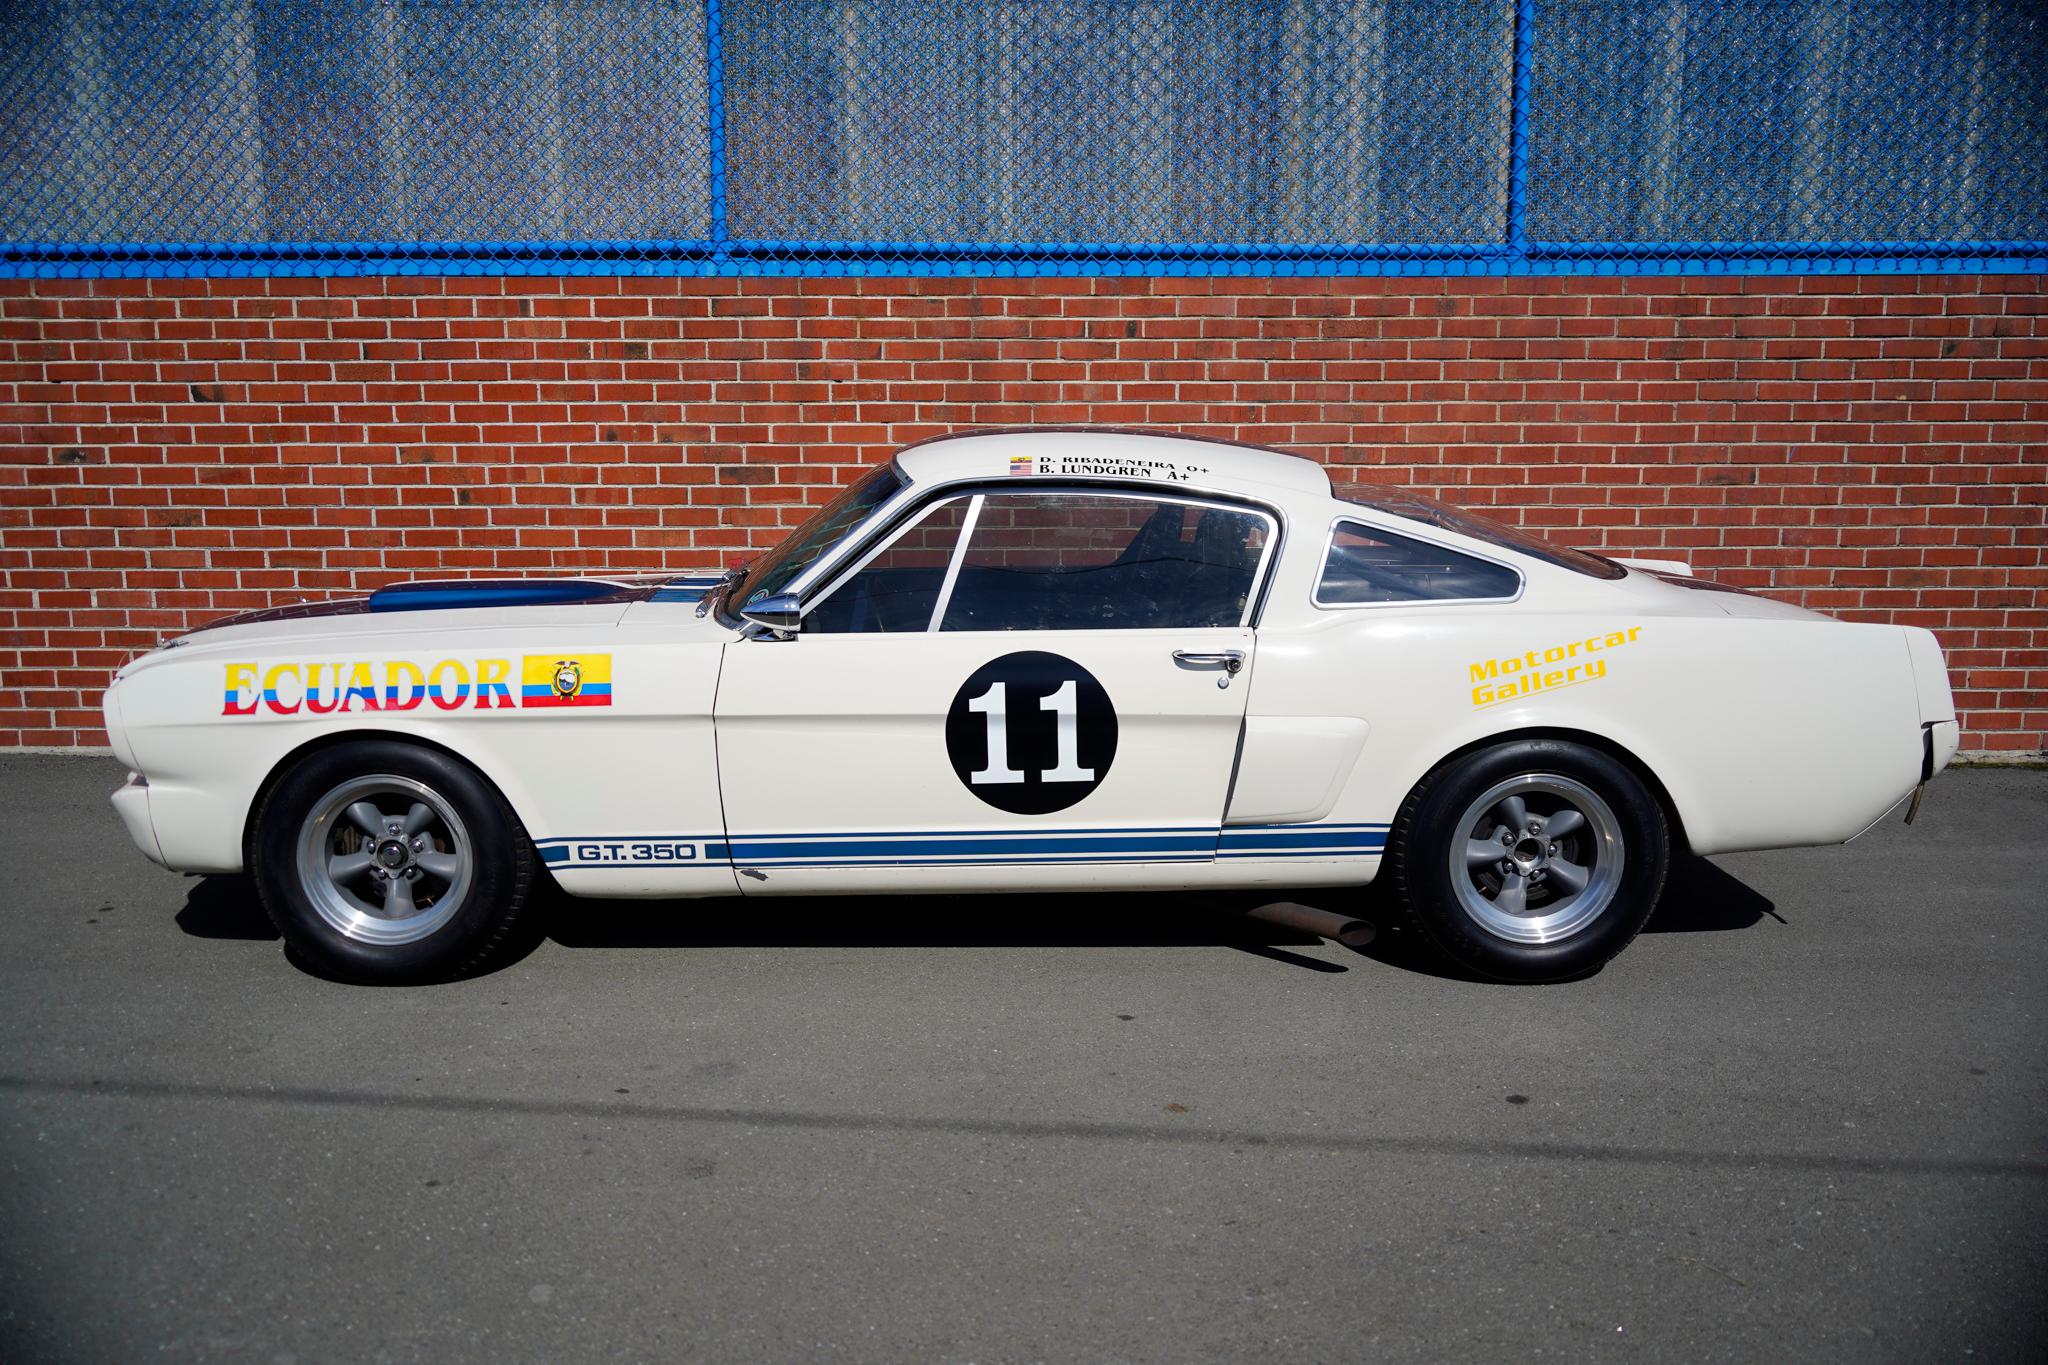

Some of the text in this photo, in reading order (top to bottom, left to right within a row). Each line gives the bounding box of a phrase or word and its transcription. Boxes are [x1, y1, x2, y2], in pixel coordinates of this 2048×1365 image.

[1039, 464, 1190, 482] B. LUNDGREN A+
[1062, 456, 1176, 470] RIBADENEIRA
[1469, 625, 1643, 684] Motorcar
[221, 658, 516, 716] ECUADOR
[1471, 658, 1607, 706] Gallery
[968, 680, 1095, 785] 11
